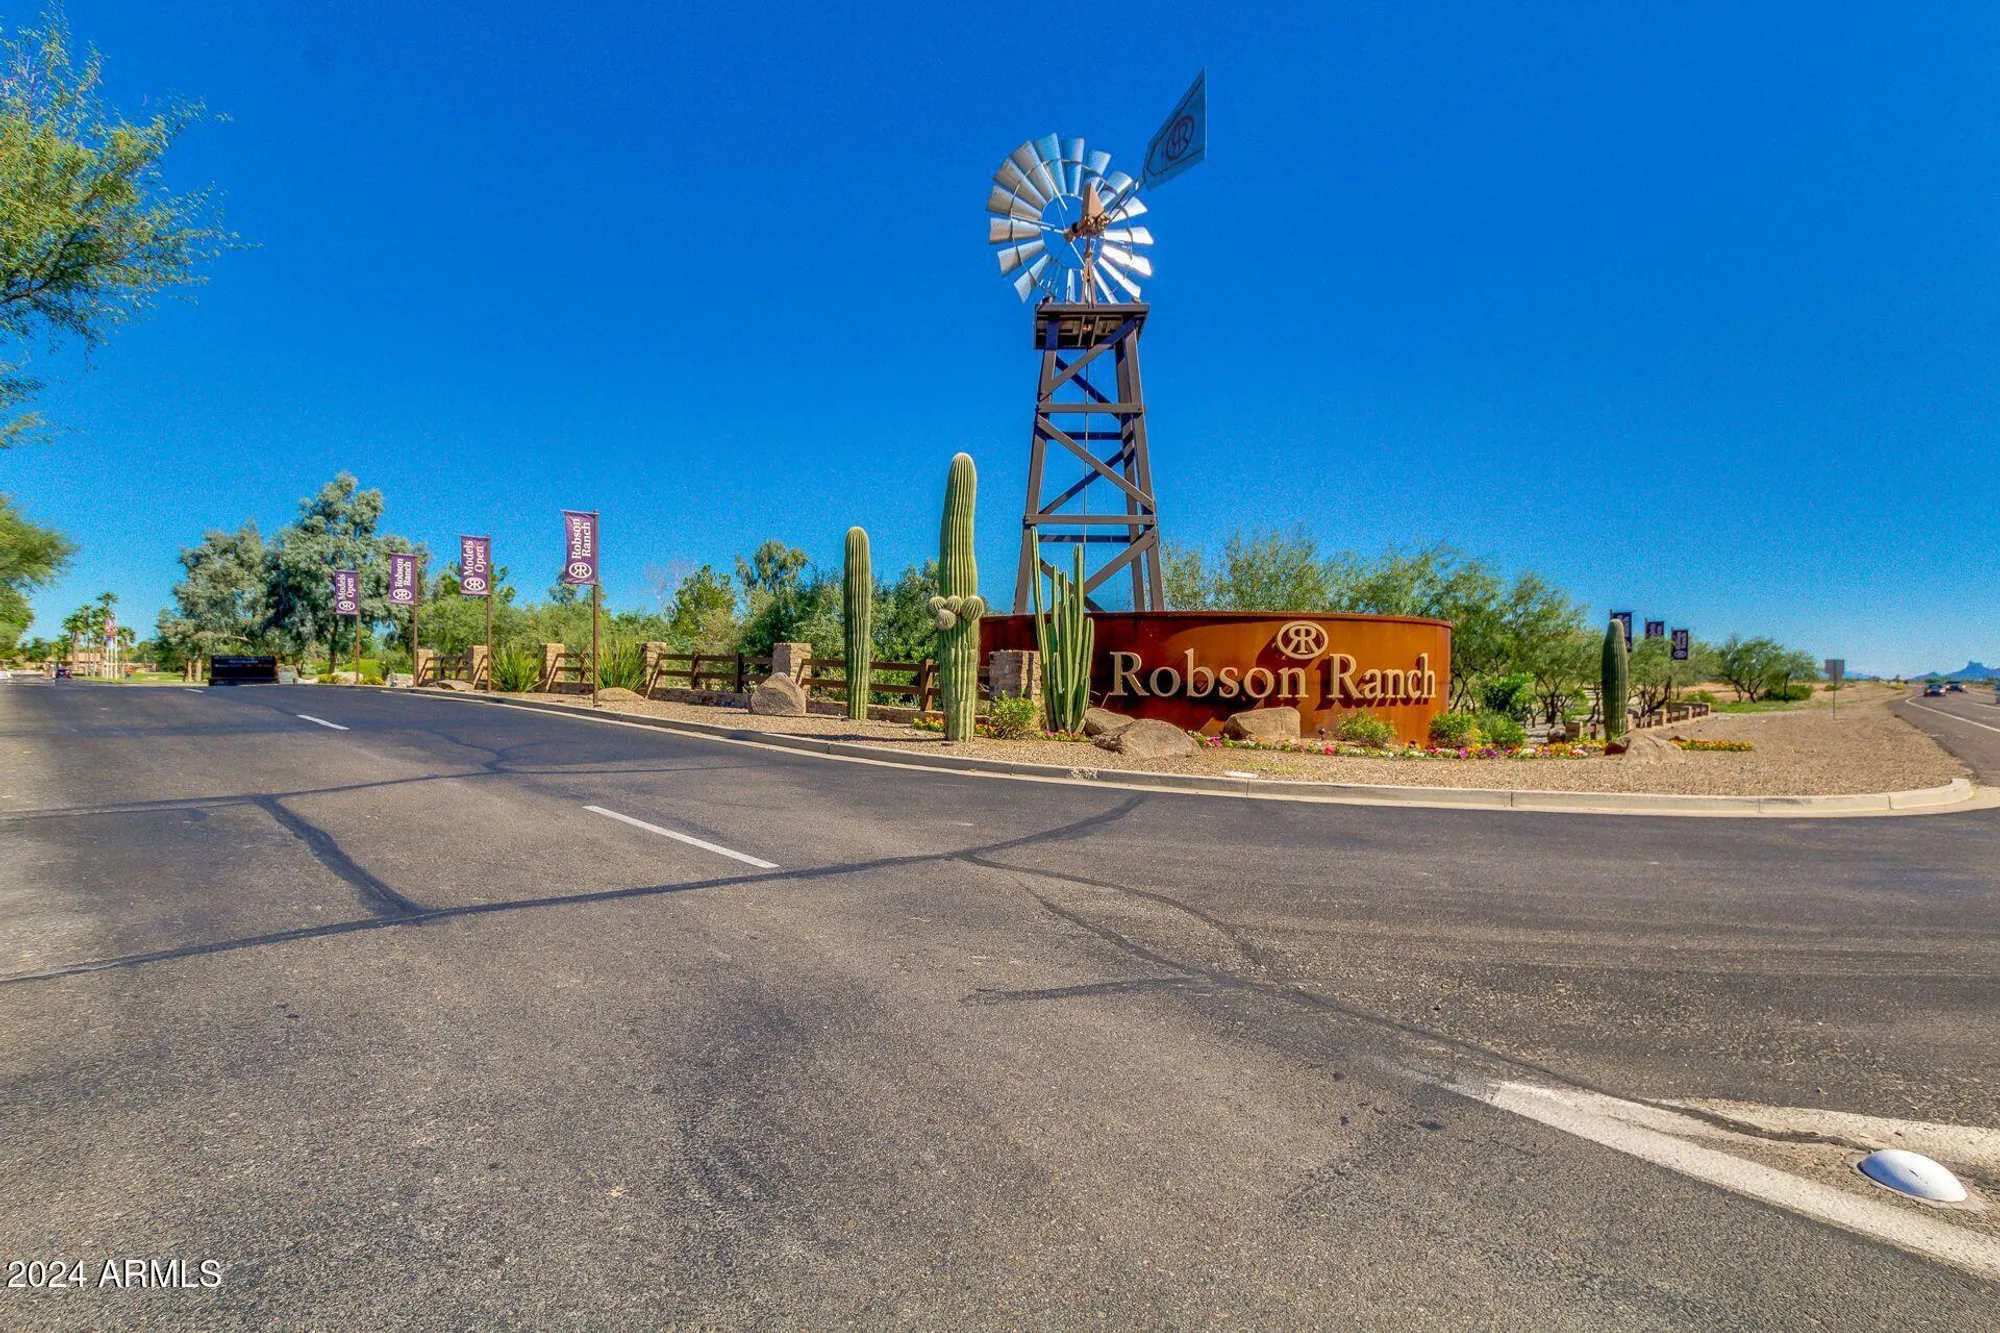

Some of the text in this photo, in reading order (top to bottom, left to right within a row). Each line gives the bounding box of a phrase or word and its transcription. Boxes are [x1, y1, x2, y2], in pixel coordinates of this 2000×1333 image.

[571, 518, 581, 560] Robson
[581, 522, 591, 557] Ranch
[394, 558, 403, 588] Robson
[463, 540, 474, 576] Models
[475, 546, 486, 573] Open
[346, 577, 356, 598] Open
[1109, 648, 1436, 700] Robson Ranch
